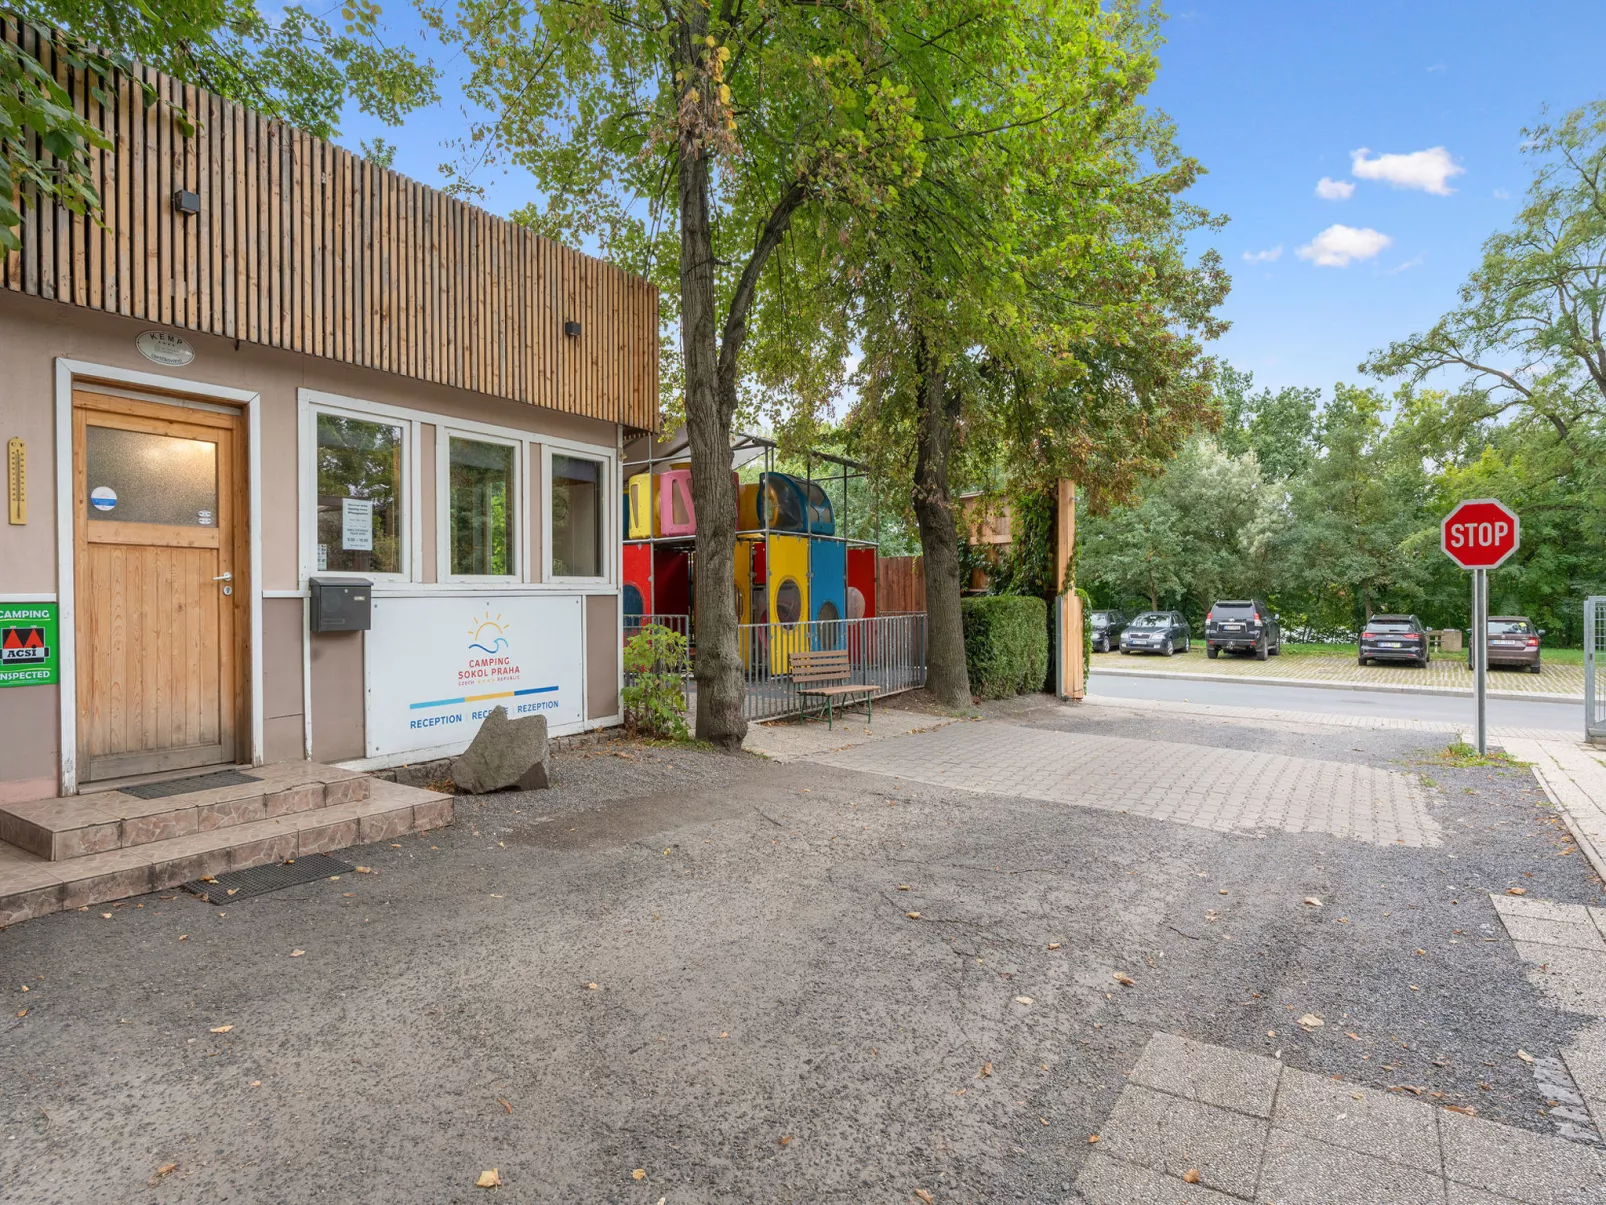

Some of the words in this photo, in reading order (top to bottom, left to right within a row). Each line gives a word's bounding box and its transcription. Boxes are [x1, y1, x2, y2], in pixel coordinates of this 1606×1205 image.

[150, 333, 182, 344] KEMP
[1450, 521, 1508, 548] STOP
[469, 657, 510, 668] CAMPING
[0, 671, 50, 680] NSPECTED
[458, 669, 488, 680] SOKOL
[491, 665, 520, 676] PRAHA
[410, 714, 462, 729] RECEPTION
[471, 706, 509, 720] RECE
[517, 700, 559, 713] REZEPTION
